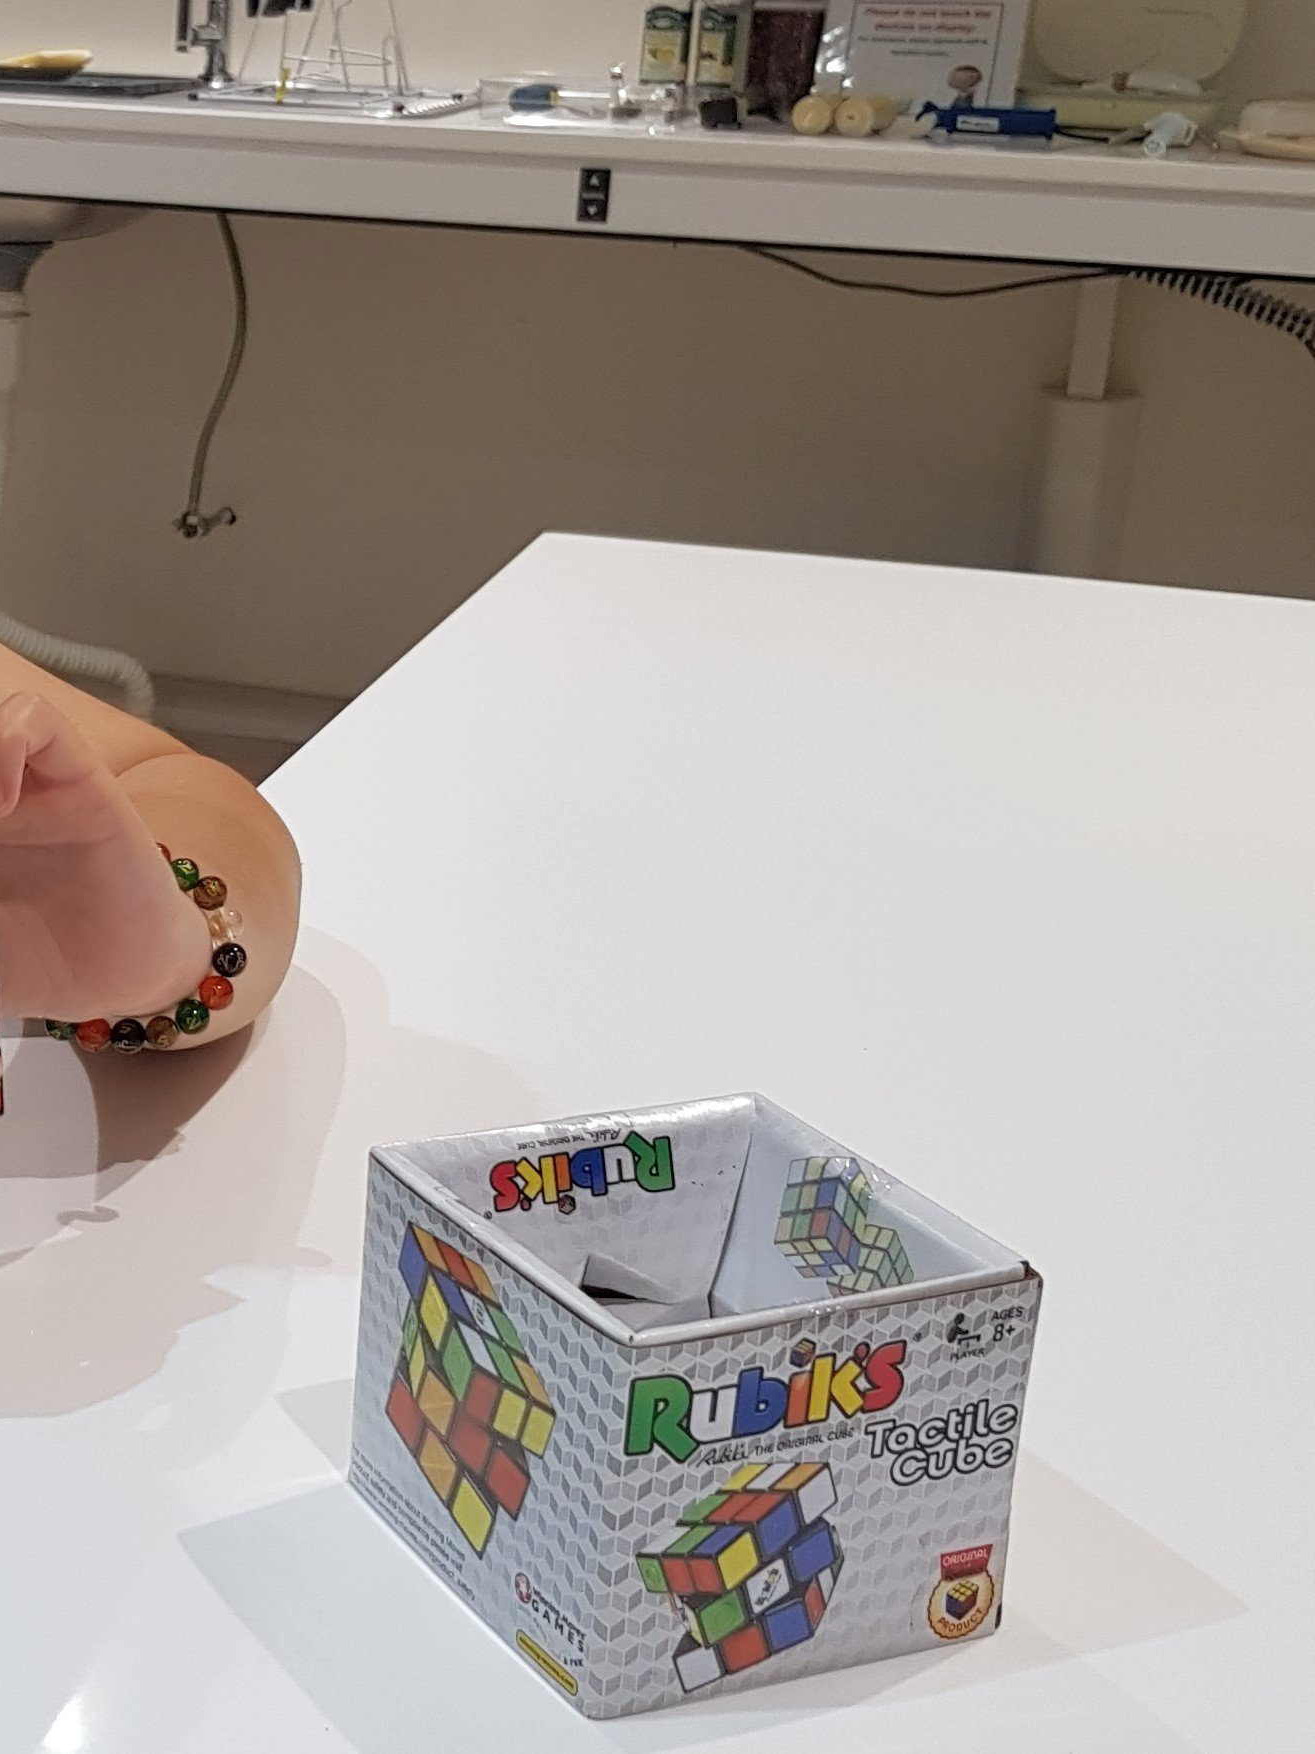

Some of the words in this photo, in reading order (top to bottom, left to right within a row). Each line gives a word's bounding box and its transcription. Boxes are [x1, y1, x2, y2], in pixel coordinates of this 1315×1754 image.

[991, 1306, 1025, 1321] AGES
[993, 1323, 1016, 1342] 8+
[949, 1348, 986, 1363] PLAYER
[777, 1436, 824, 1452] ORIGINAL
[827, 1426, 856, 1441] CUBE
[865, 1398, 1019, 1459] Tactile
[890, 1438, 1014, 1487] Cube
[942, 1549, 990, 1567] ORIGINAL
[531, 1598, 584, 1653] GAMES
[937, 1607, 984, 1633] PRODUCT
